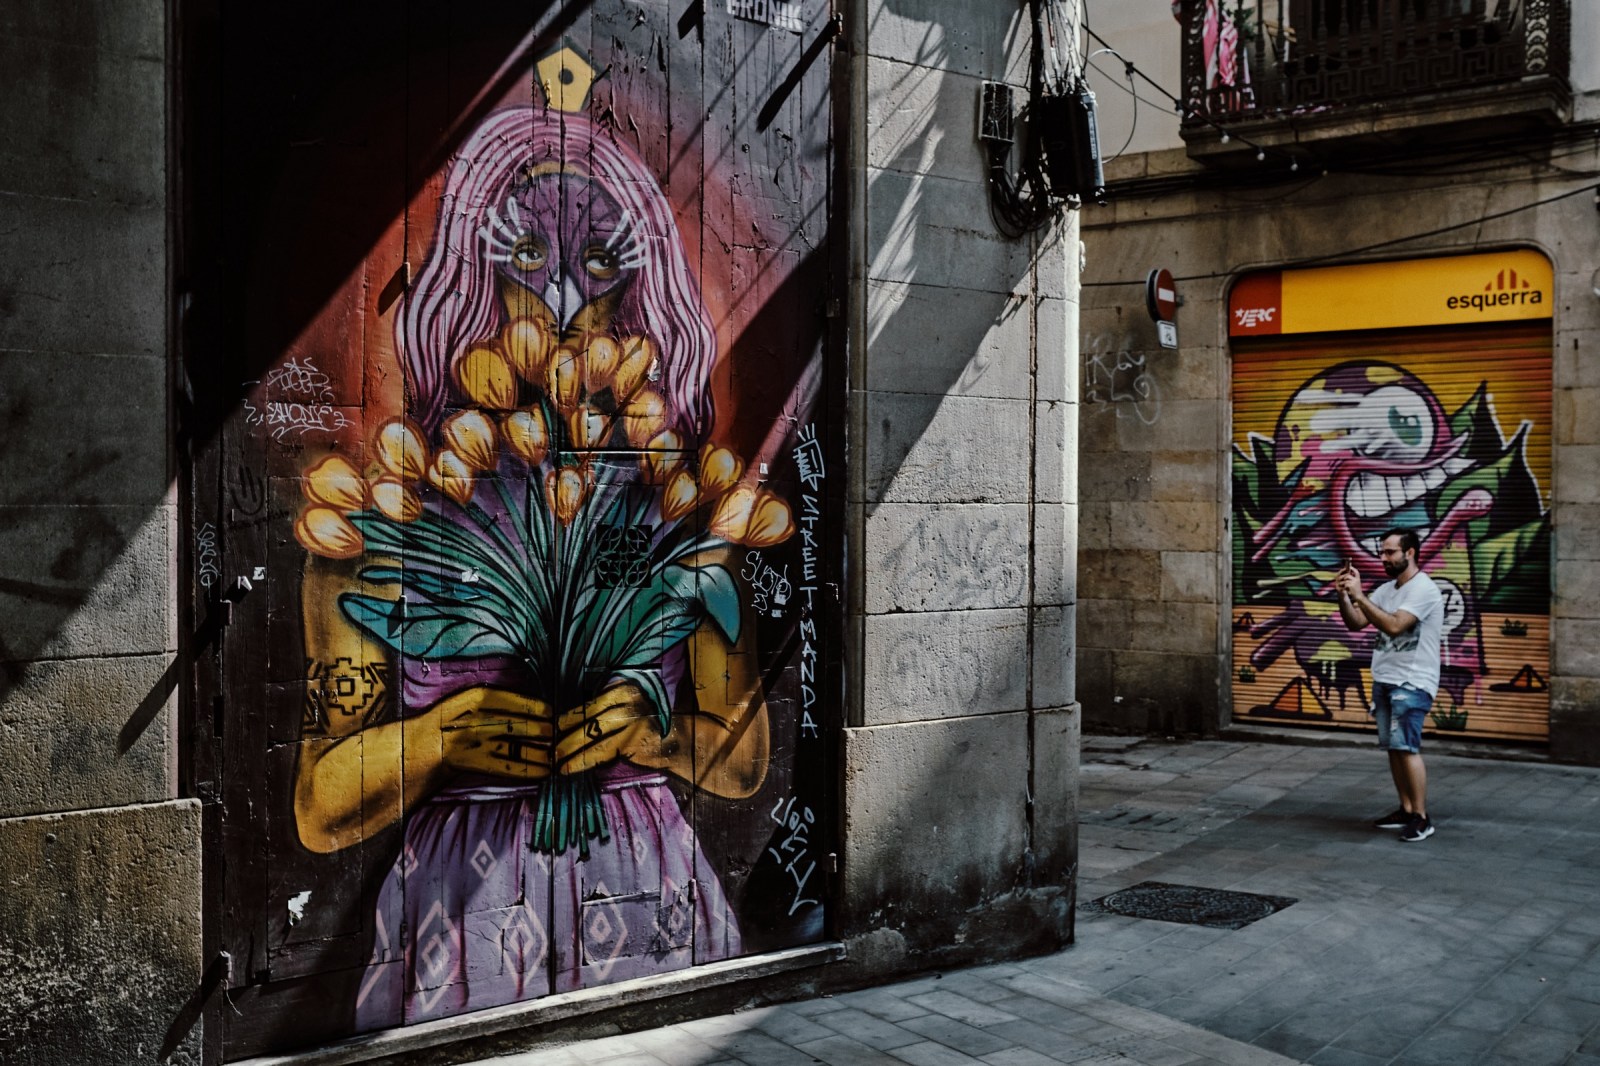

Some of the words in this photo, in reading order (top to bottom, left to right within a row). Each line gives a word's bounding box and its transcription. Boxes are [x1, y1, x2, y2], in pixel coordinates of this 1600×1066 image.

[1446, 287, 1543, 312] esquerra
[799, 494, 820, 610] STREET
[799, 619, 819, 740] MANDA
